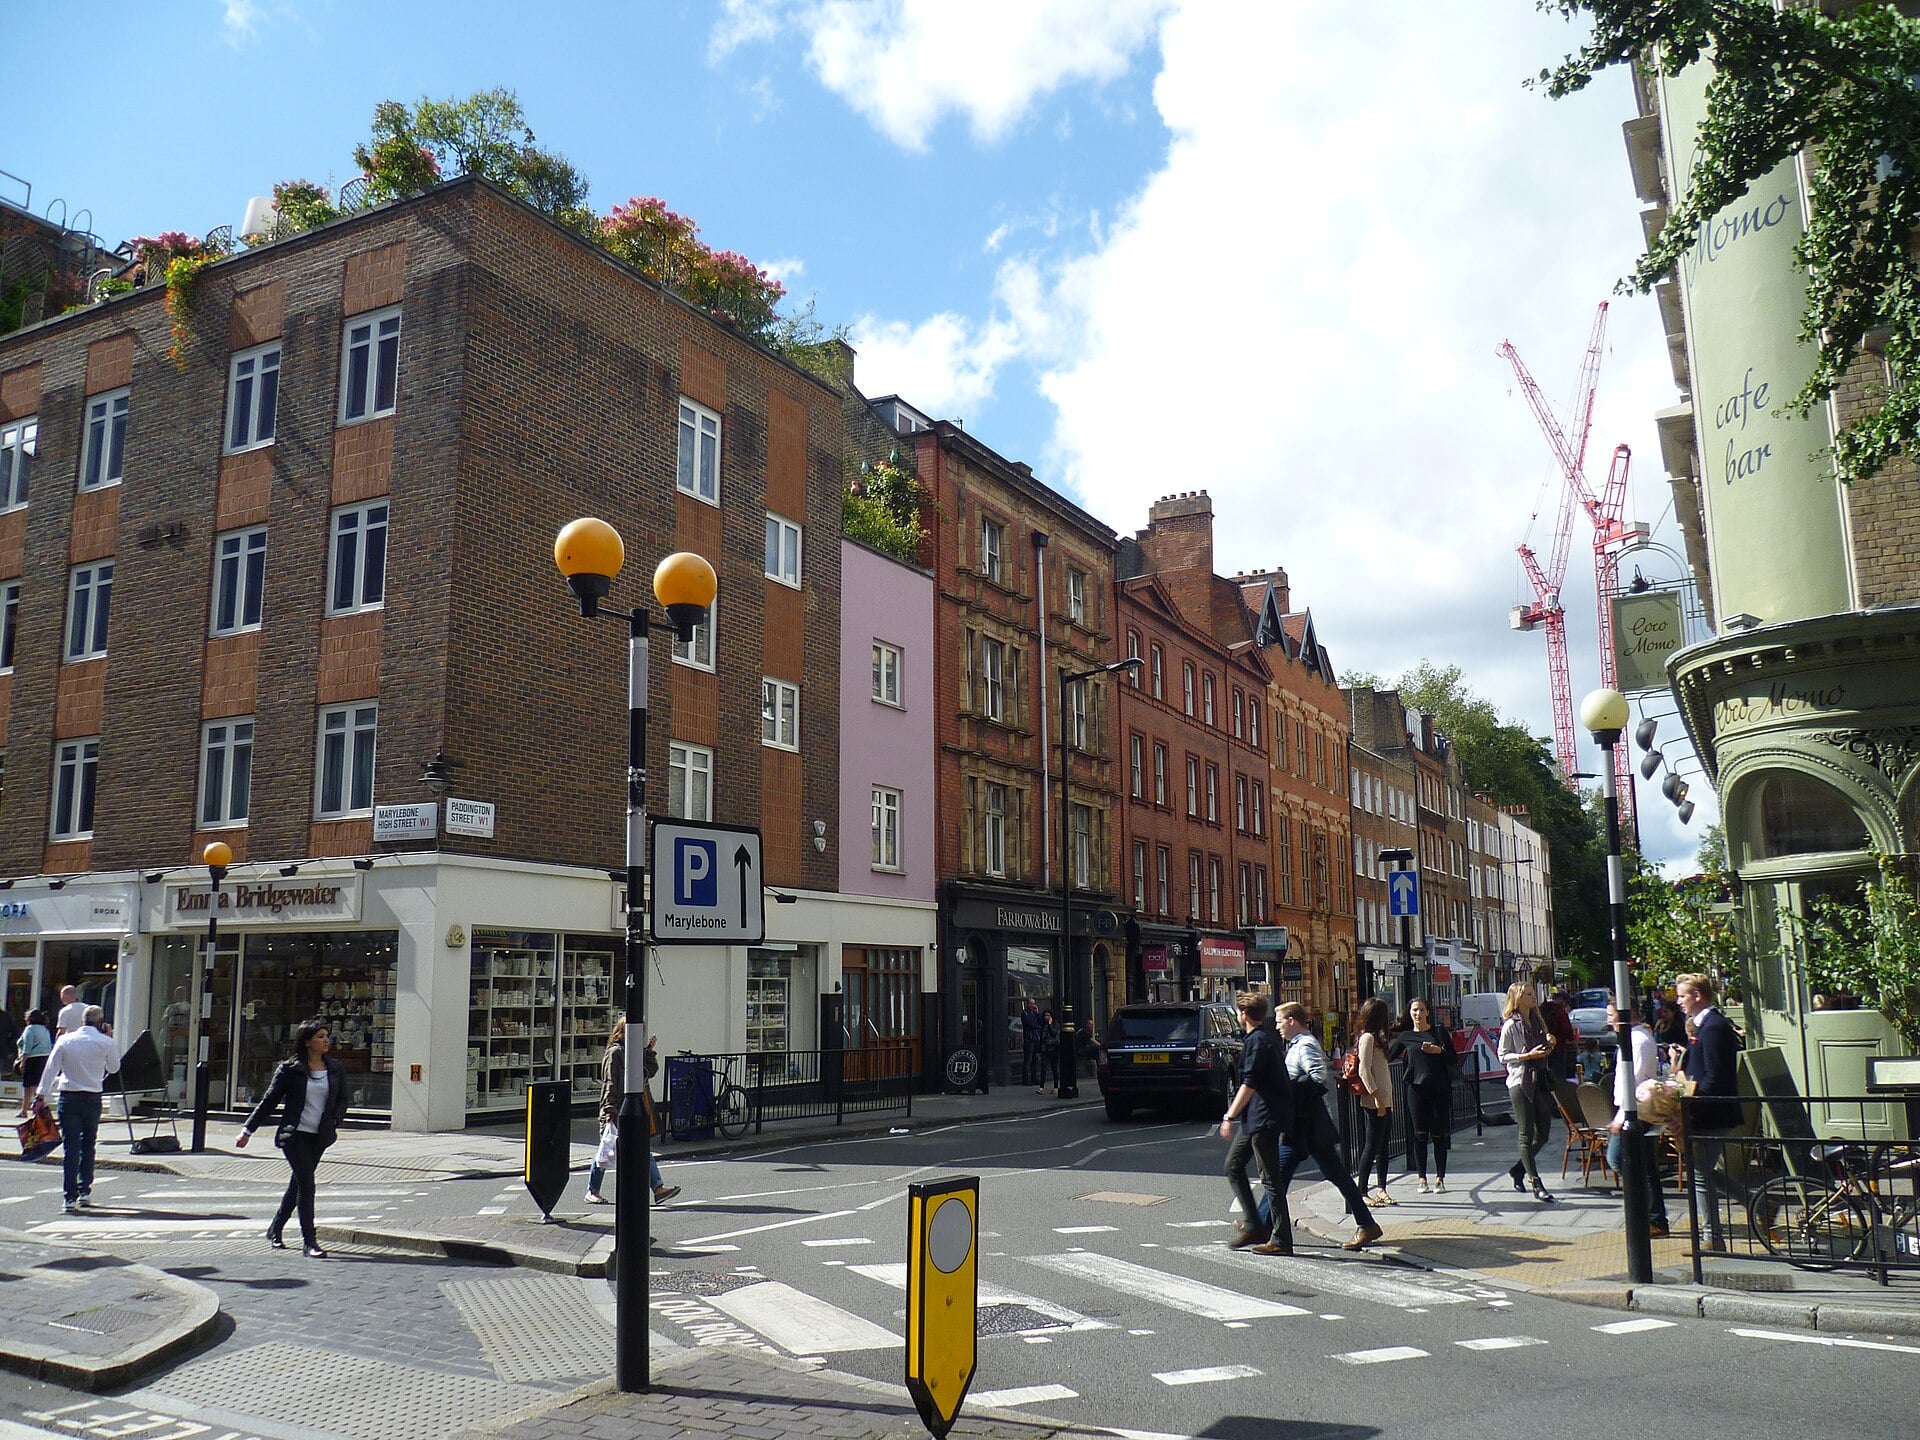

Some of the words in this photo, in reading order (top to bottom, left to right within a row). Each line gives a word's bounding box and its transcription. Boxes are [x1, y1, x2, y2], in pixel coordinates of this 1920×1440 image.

[1689, 194, 1792, 288] Momo
[1716, 367, 1770, 431] cafe
[1725, 438, 1771, 485] bar
[1628, 617, 1668, 636] Coco
[1623, 637, 1676, 656] Momo
[1748, 682, 1846, 722] Momo
[379, 807, 419, 819] MARYLEBONE
[451, 802, 490, 815] PADDINGTON
[378, 820, 392, 829] HIGH
[393, 818, 417, 829] STREET
[420, 818, 430, 827] W1
[451, 813, 474, 824] STREET
[479, 816, 488, 825] W1
[684, 845, 709, 899] P
[236, 882, 341, 912] Bridgewater
[0, 903, 27, 918] ORA
[665, 913, 727, 930] Marylebone
[625, 973, 635, 989] 4
[549, 1093, 555, 1102] 2
[45, 1231, 173, 1240] LOOK
